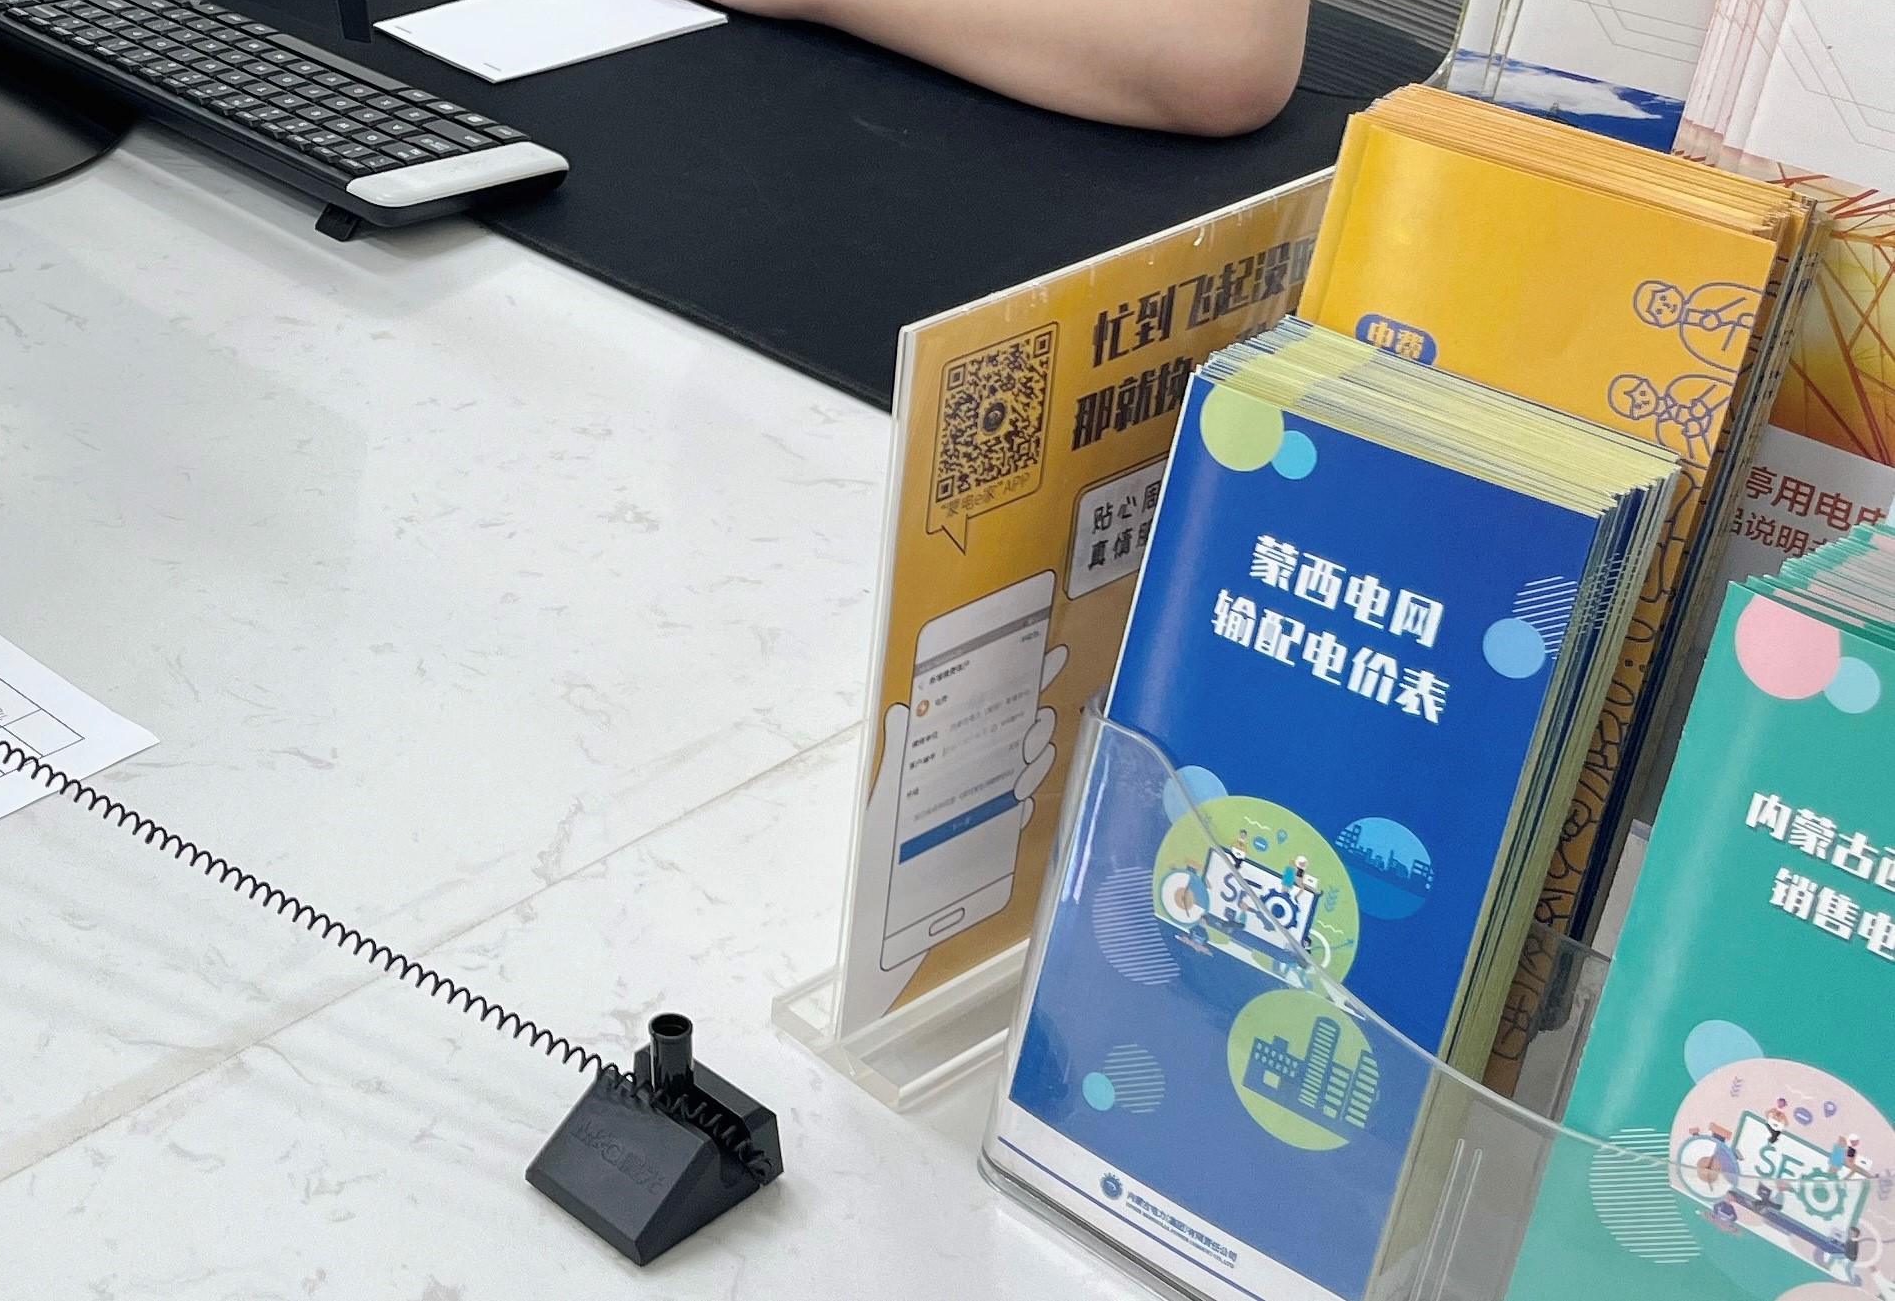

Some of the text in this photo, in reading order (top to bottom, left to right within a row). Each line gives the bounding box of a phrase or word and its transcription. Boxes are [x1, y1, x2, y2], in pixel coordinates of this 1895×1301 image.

[1249, 534, 1444, 648] 蒙西电网
[1211, 588, 1450, 725] 输配电价表
